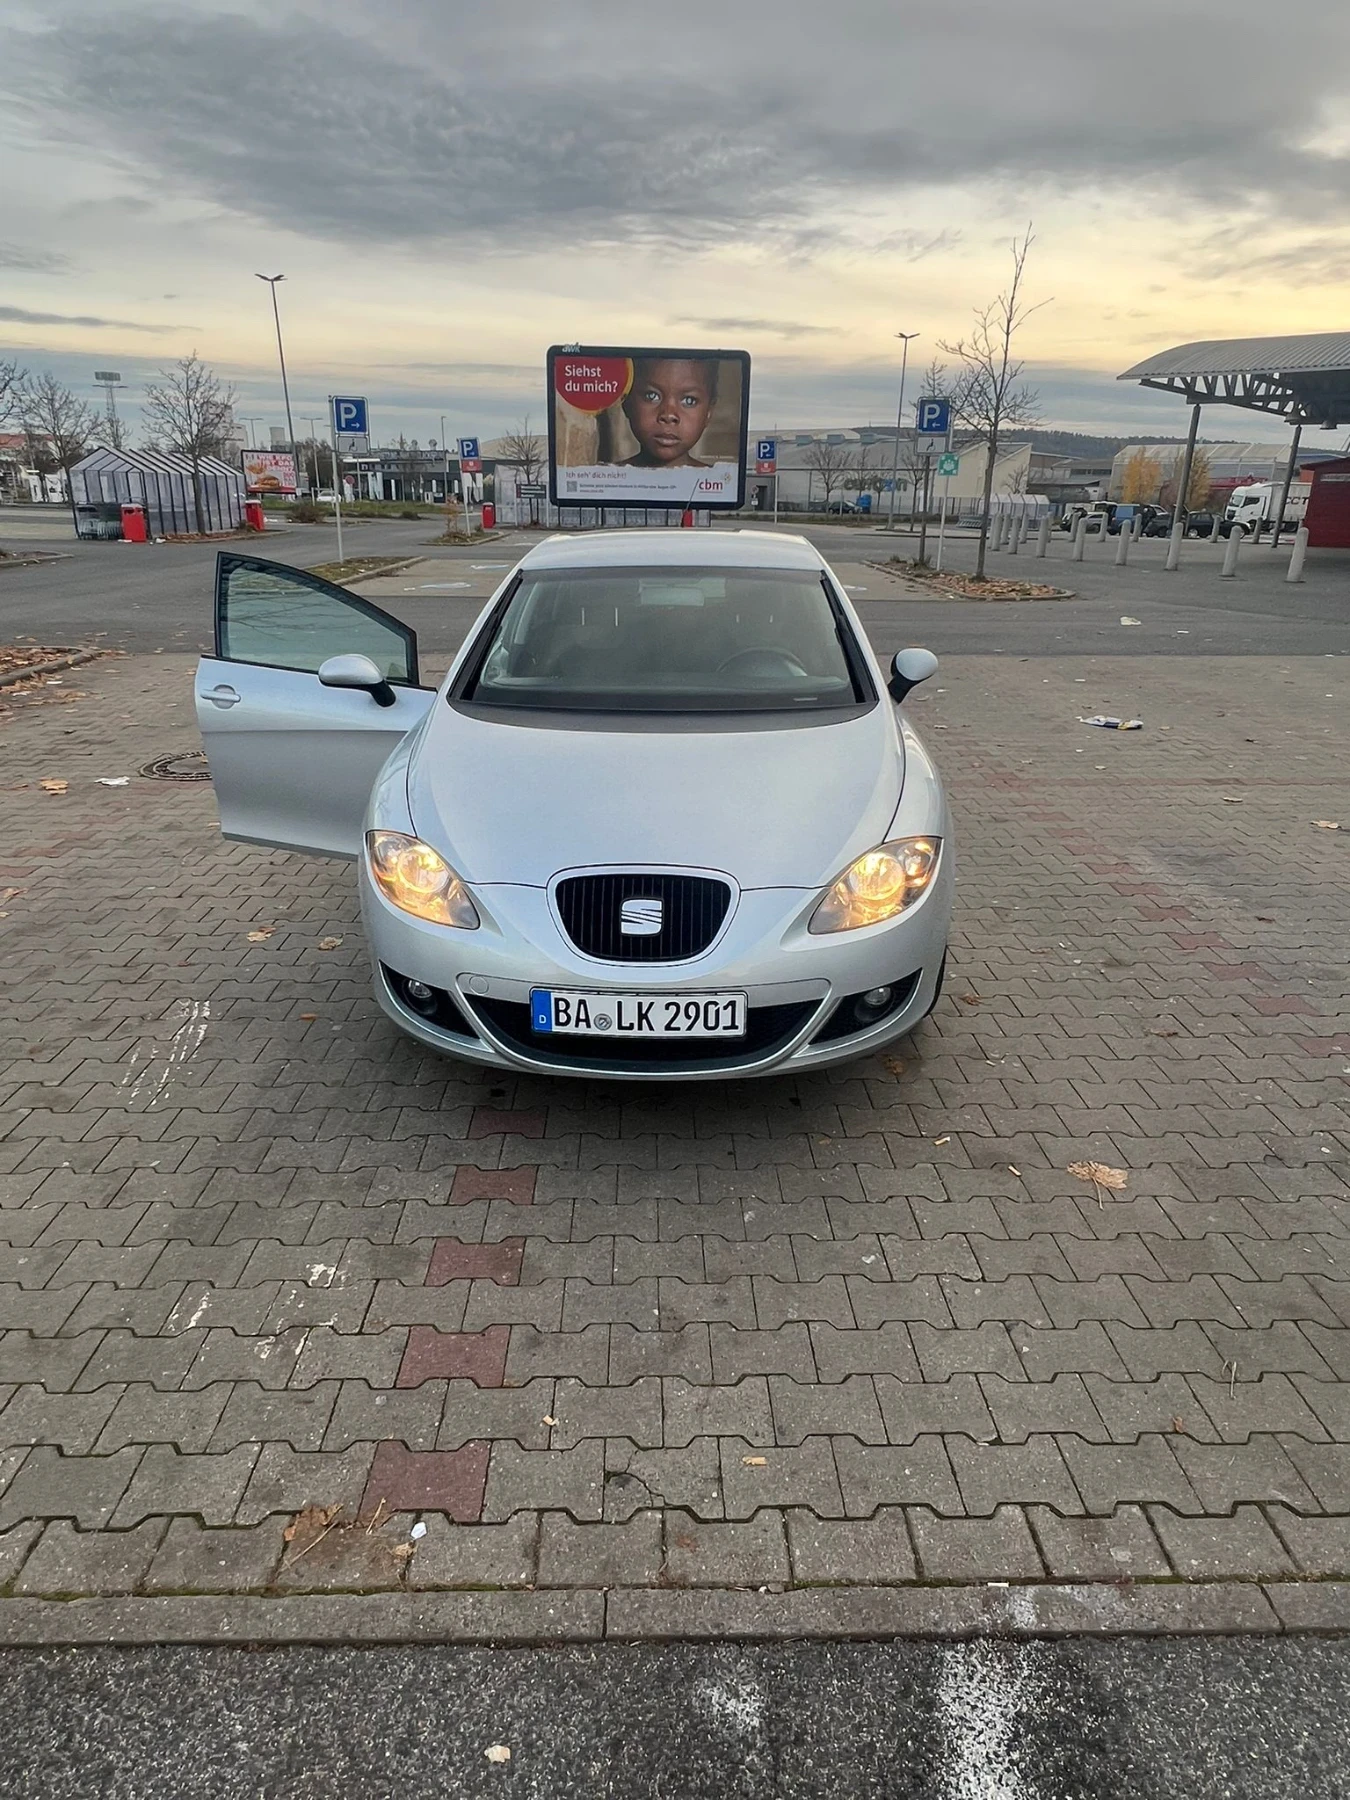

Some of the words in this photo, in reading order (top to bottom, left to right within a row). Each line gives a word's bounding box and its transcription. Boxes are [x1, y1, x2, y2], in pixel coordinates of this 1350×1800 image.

[565, 365, 602, 377] Siehst
[565, 380, 580, 392] du
[583, 381, 618, 393] mich?
[340, 402, 357, 428] P
[922, 404, 941, 429] P
[462, 441, 474, 457] P
[760, 443, 771, 458] P
[699, 477, 723, 490] cbm
[539, 1014, 546, 1024] D
[553, 997, 592, 1029] BA
[616, 1000, 656, 1031] LK
[664, 1000, 739, 1031] 2901
